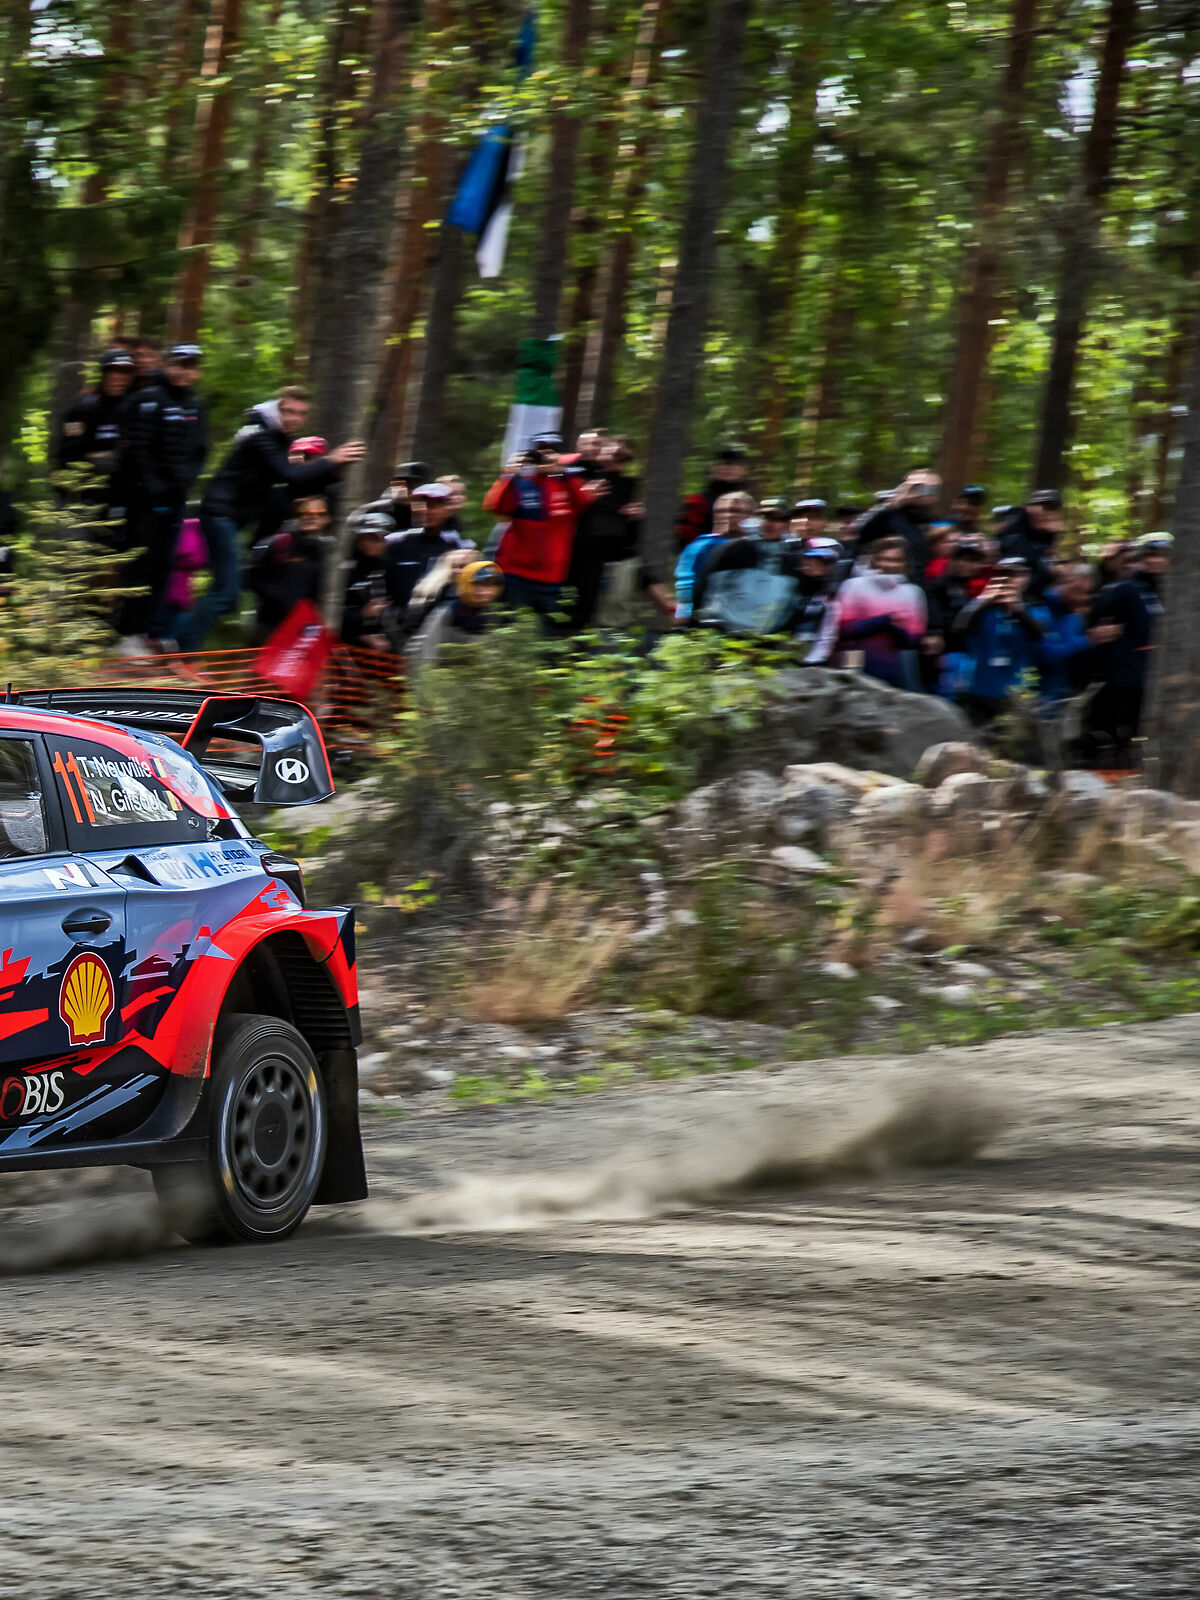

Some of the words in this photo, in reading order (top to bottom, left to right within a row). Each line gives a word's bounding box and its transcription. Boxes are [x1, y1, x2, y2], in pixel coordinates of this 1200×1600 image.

[74, 709, 198, 720] HYUND
[76, 756, 95, 778] T.
[93, 756, 152, 778] Neuville
[53, 751, 96, 823] 11
[90, 790, 111, 812] N.
[111, 788, 160, 812] Gilsoul
[207, 849, 252, 862] HYUNDAI
[218, 861, 253, 875] STEEL
